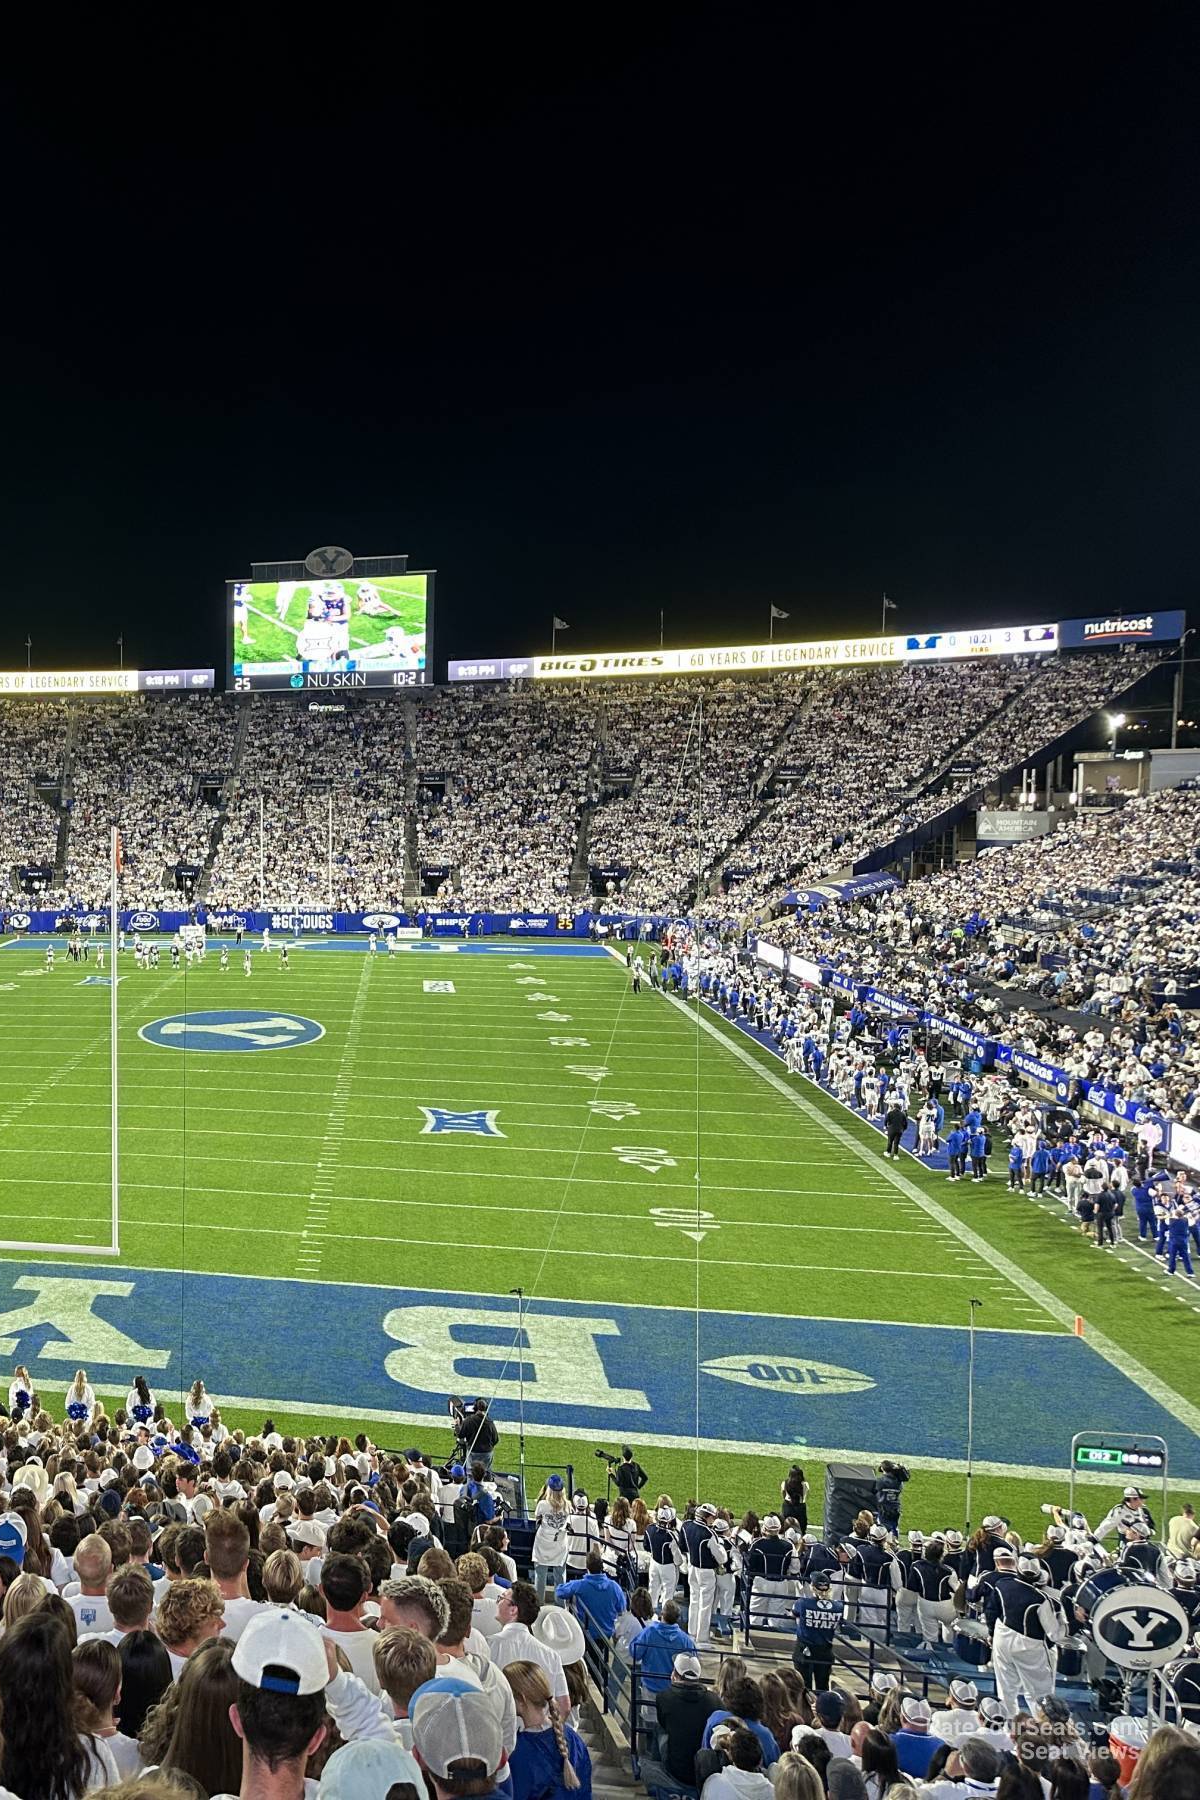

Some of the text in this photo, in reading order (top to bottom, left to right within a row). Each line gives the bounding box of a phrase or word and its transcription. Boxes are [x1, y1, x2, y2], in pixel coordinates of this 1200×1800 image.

[1084, 616, 1153, 633] nutricost
[690, 642, 895, 666] 60 YEARS OF LEGENDARY SERVICE
[479, 665, 495, 676] PM
[540, 660, 576, 671] BIG
[601, 656, 664, 668] TIRES
[14, 675, 25, 688] OF
[30, 675, 84, 688] LEGENDARY
[90, 674, 129, 688] SERVICE
[164, 675, 179, 685] PM
[235, 677, 251, 690] 25
[307, 672, 366, 687] NU SKIN
[393, 671, 425, 685] 10:21
[996, 818, 1038, 826] MOUNTAIN
[998, 825, 1034, 833] AMERICA
[876, 878, 897, 889] BANK
[557, 918, 574, 930] 25
[944, 1022, 978, 1046] FOOTBALL
[1023, 1058, 1053, 1081] COUGS
[611, 1146, 678, 1166] 20
[649, 1207, 721, 1229] 10
[747, 1363, 828, 1384] 100
[805, 1609, 842, 1621] EVENT
